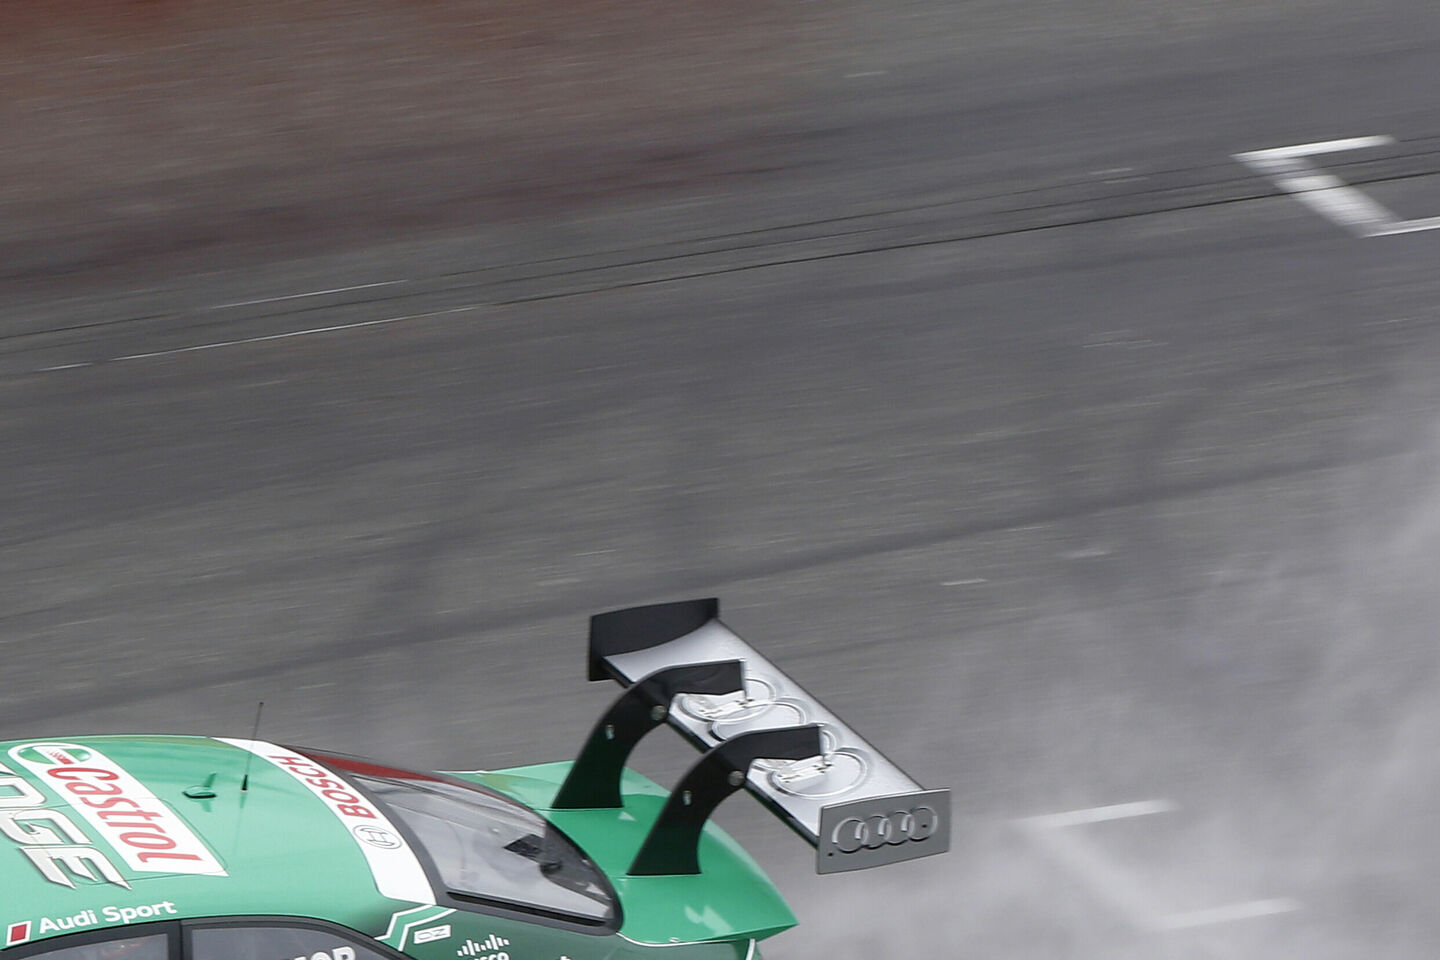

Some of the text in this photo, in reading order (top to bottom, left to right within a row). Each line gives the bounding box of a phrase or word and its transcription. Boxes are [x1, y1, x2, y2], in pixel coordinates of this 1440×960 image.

[46, 766, 204, 864] Castrol
[267, 755, 377, 819] BOSCH
[39, 901, 178, 934] Audi Sport
